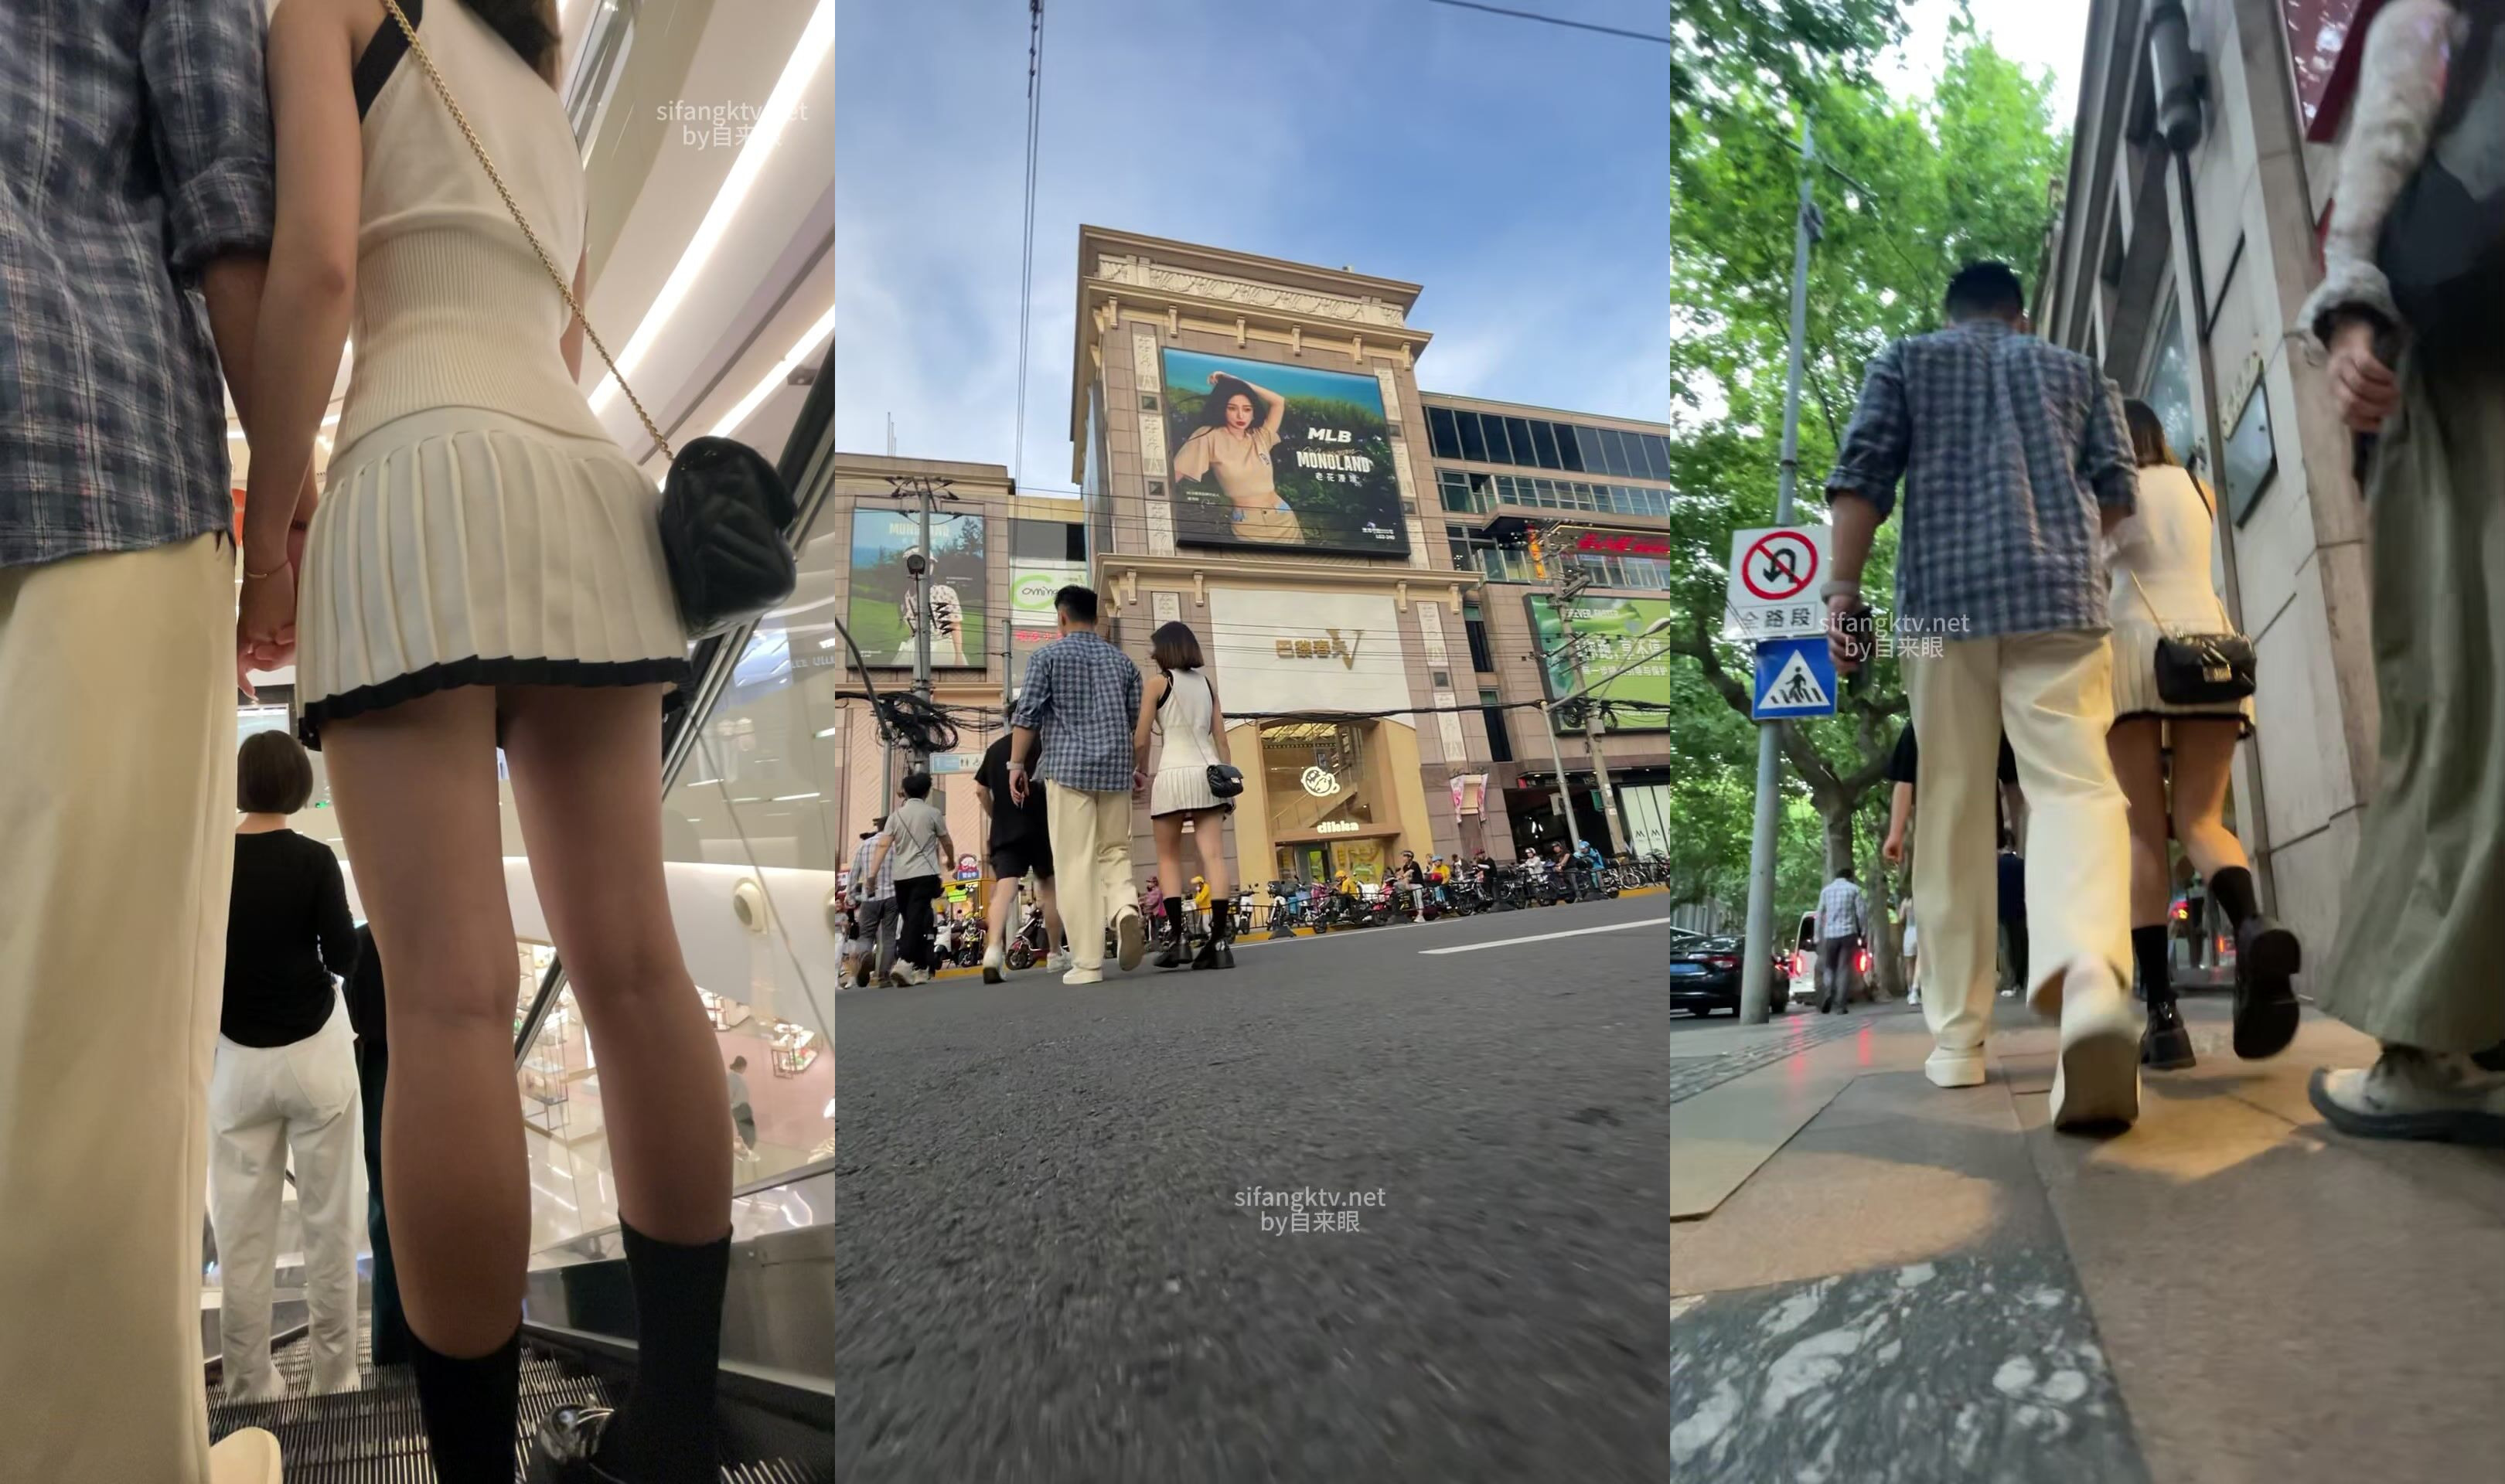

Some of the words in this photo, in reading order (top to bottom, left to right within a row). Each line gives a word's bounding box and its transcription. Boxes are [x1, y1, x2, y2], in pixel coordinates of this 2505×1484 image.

[1307, 427, 1352, 443] MLB
[1296, 451, 1372, 473] MONOLAND
[1742, 608, 1811, 629] 全路段
